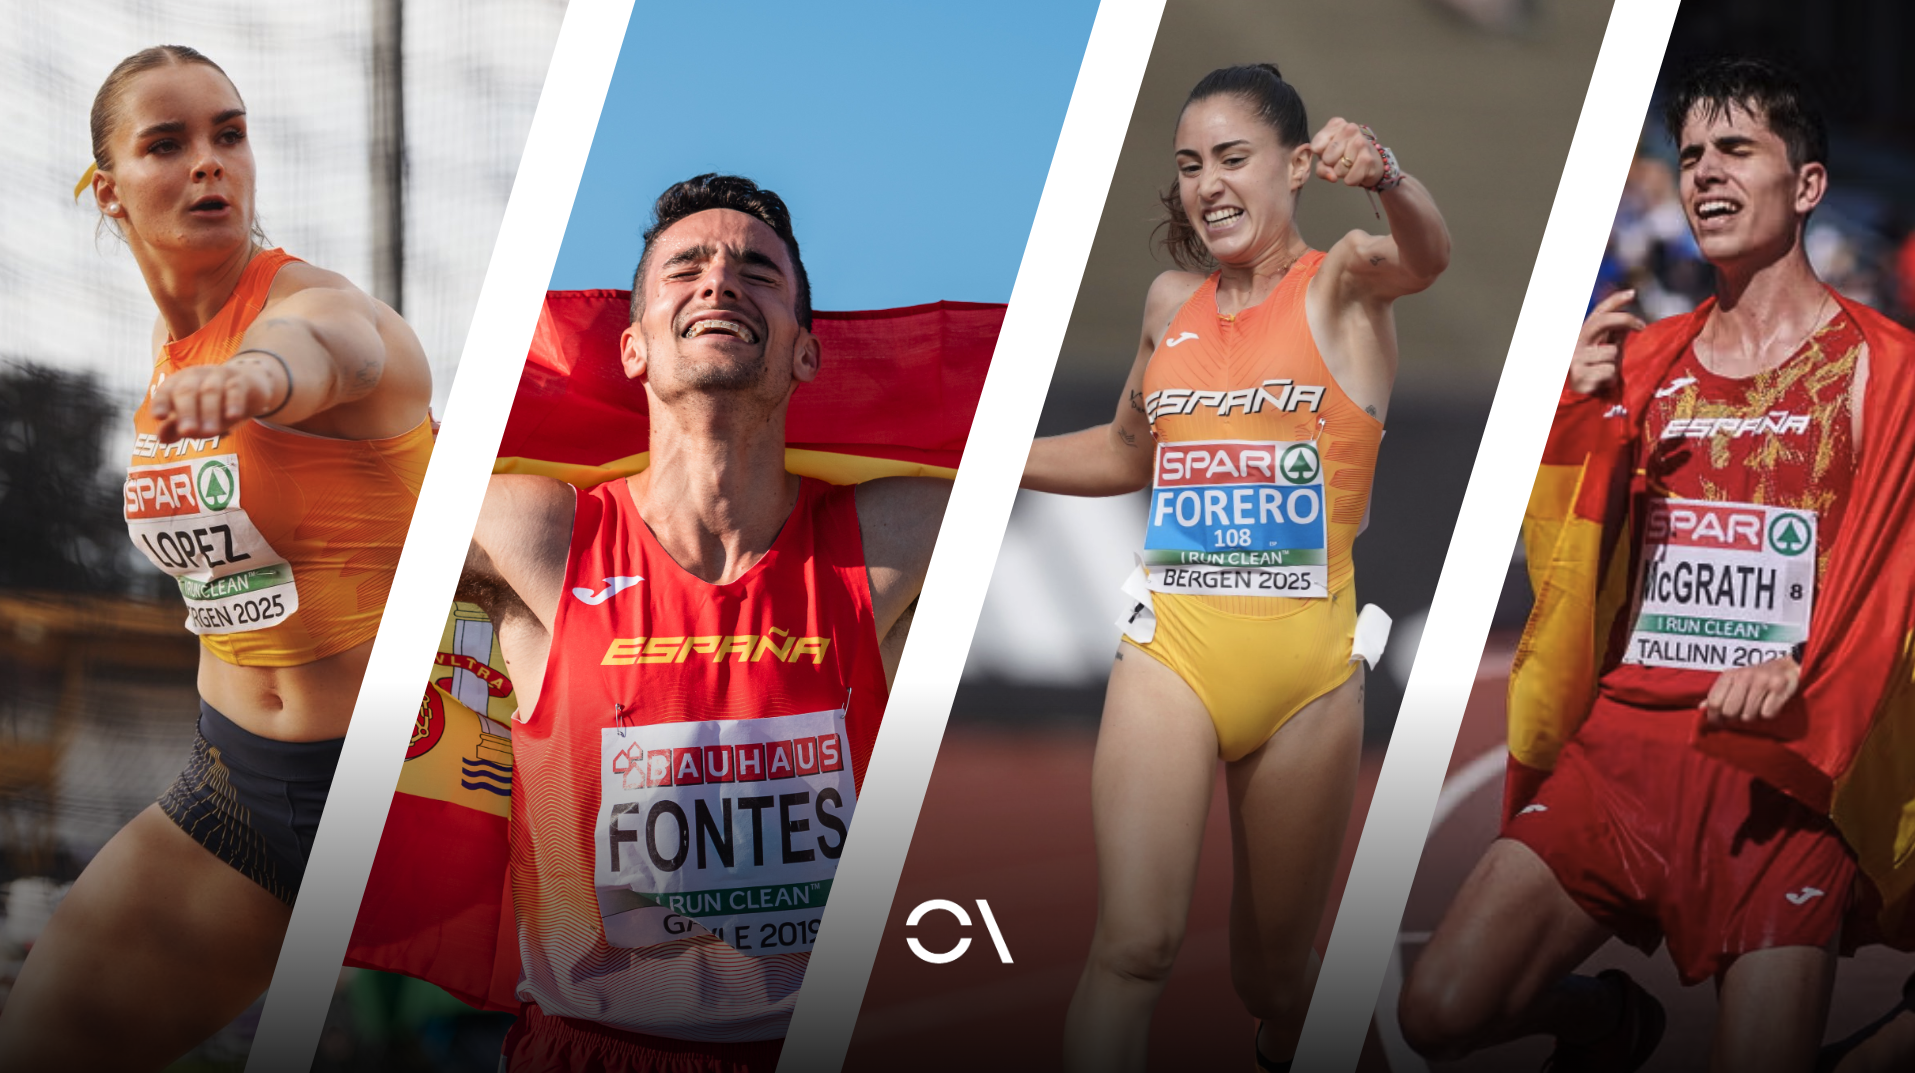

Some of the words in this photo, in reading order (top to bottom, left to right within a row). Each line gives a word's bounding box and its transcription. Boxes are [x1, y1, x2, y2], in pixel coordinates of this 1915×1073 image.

[1145, 379, 1326, 424] ESPAÑA
[1660, 410, 1811, 439] ESPAÑA
[1161, 449, 1273, 480] SPAR
[126, 473, 196, 513] SPAR
[1154, 488, 1320, 527] FORERO
[1214, 528, 1252, 548] 108
[1648, 510, 1760, 545] SPAR
[141, 524, 252, 568] LOPEZ
[1181, 552, 1185, 564] I
[1188, 551, 1224, 565] RUN
[1163, 569, 1252, 589] BERGEN
[1258, 571, 1312, 590] 2025
[1644, 561, 1777, 610] McGRATH
[1790, 583, 1803, 600] 8
[188, 606, 234, 628] RGEN
[233, 594, 285, 624] 2025
[1657, 617, 1663, 630] I
[1666, 617, 1701, 632] RUN
[600, 627, 831, 666] ESPAÑA
[1638, 639, 1727, 665] TALLINN
[648, 736, 842, 786] BAUHAUS
[609, 787, 848, 873] FONTES
[669, 892, 722, 914] RUN
